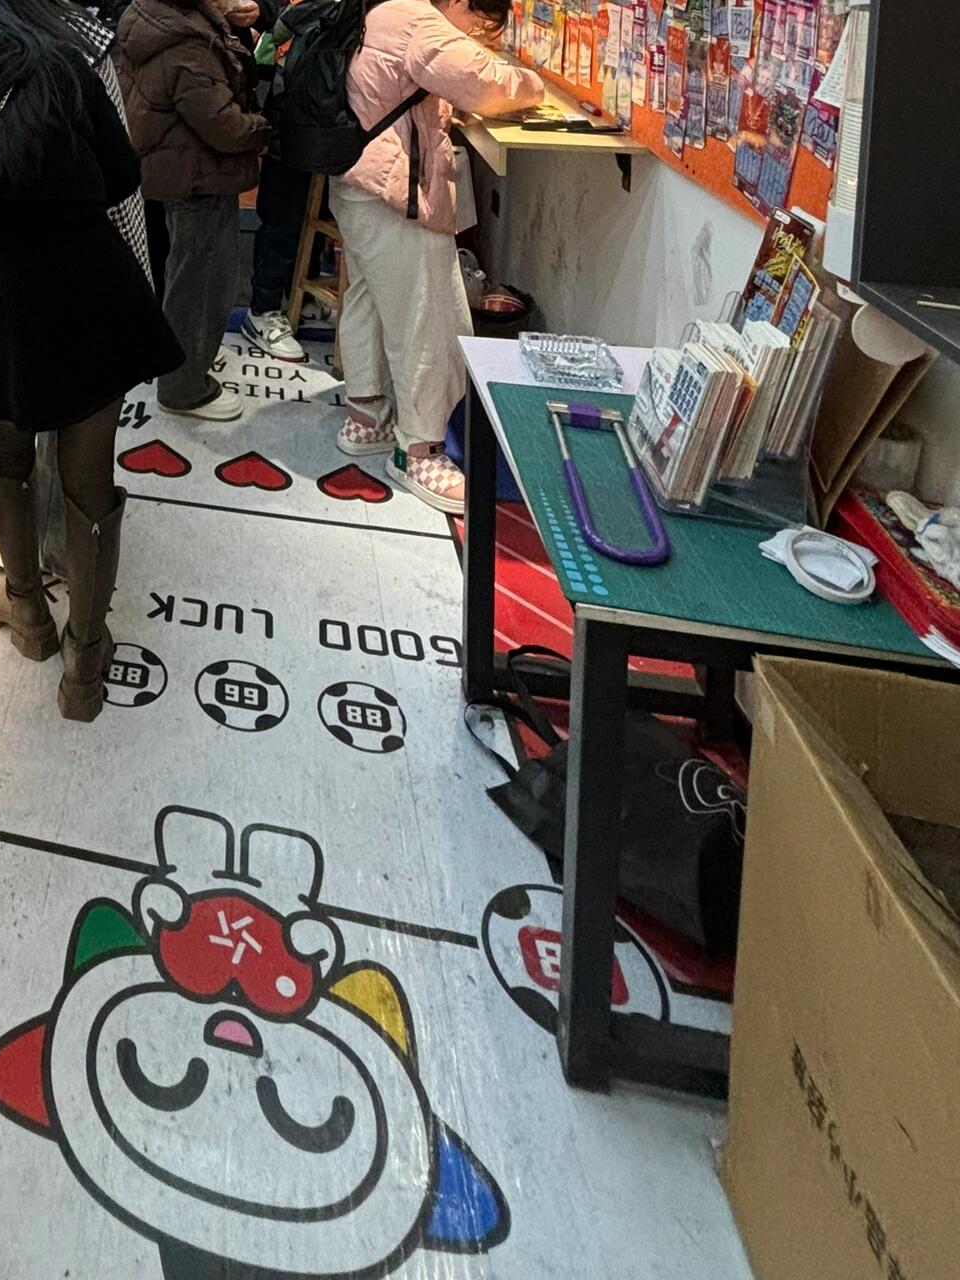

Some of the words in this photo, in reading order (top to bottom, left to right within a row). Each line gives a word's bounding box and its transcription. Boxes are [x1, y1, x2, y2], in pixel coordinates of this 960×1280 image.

[147, 592, 274, 639] LUCK
[319, 618, 462, 668] GOOD
[345, 703, 382, 729] 88
